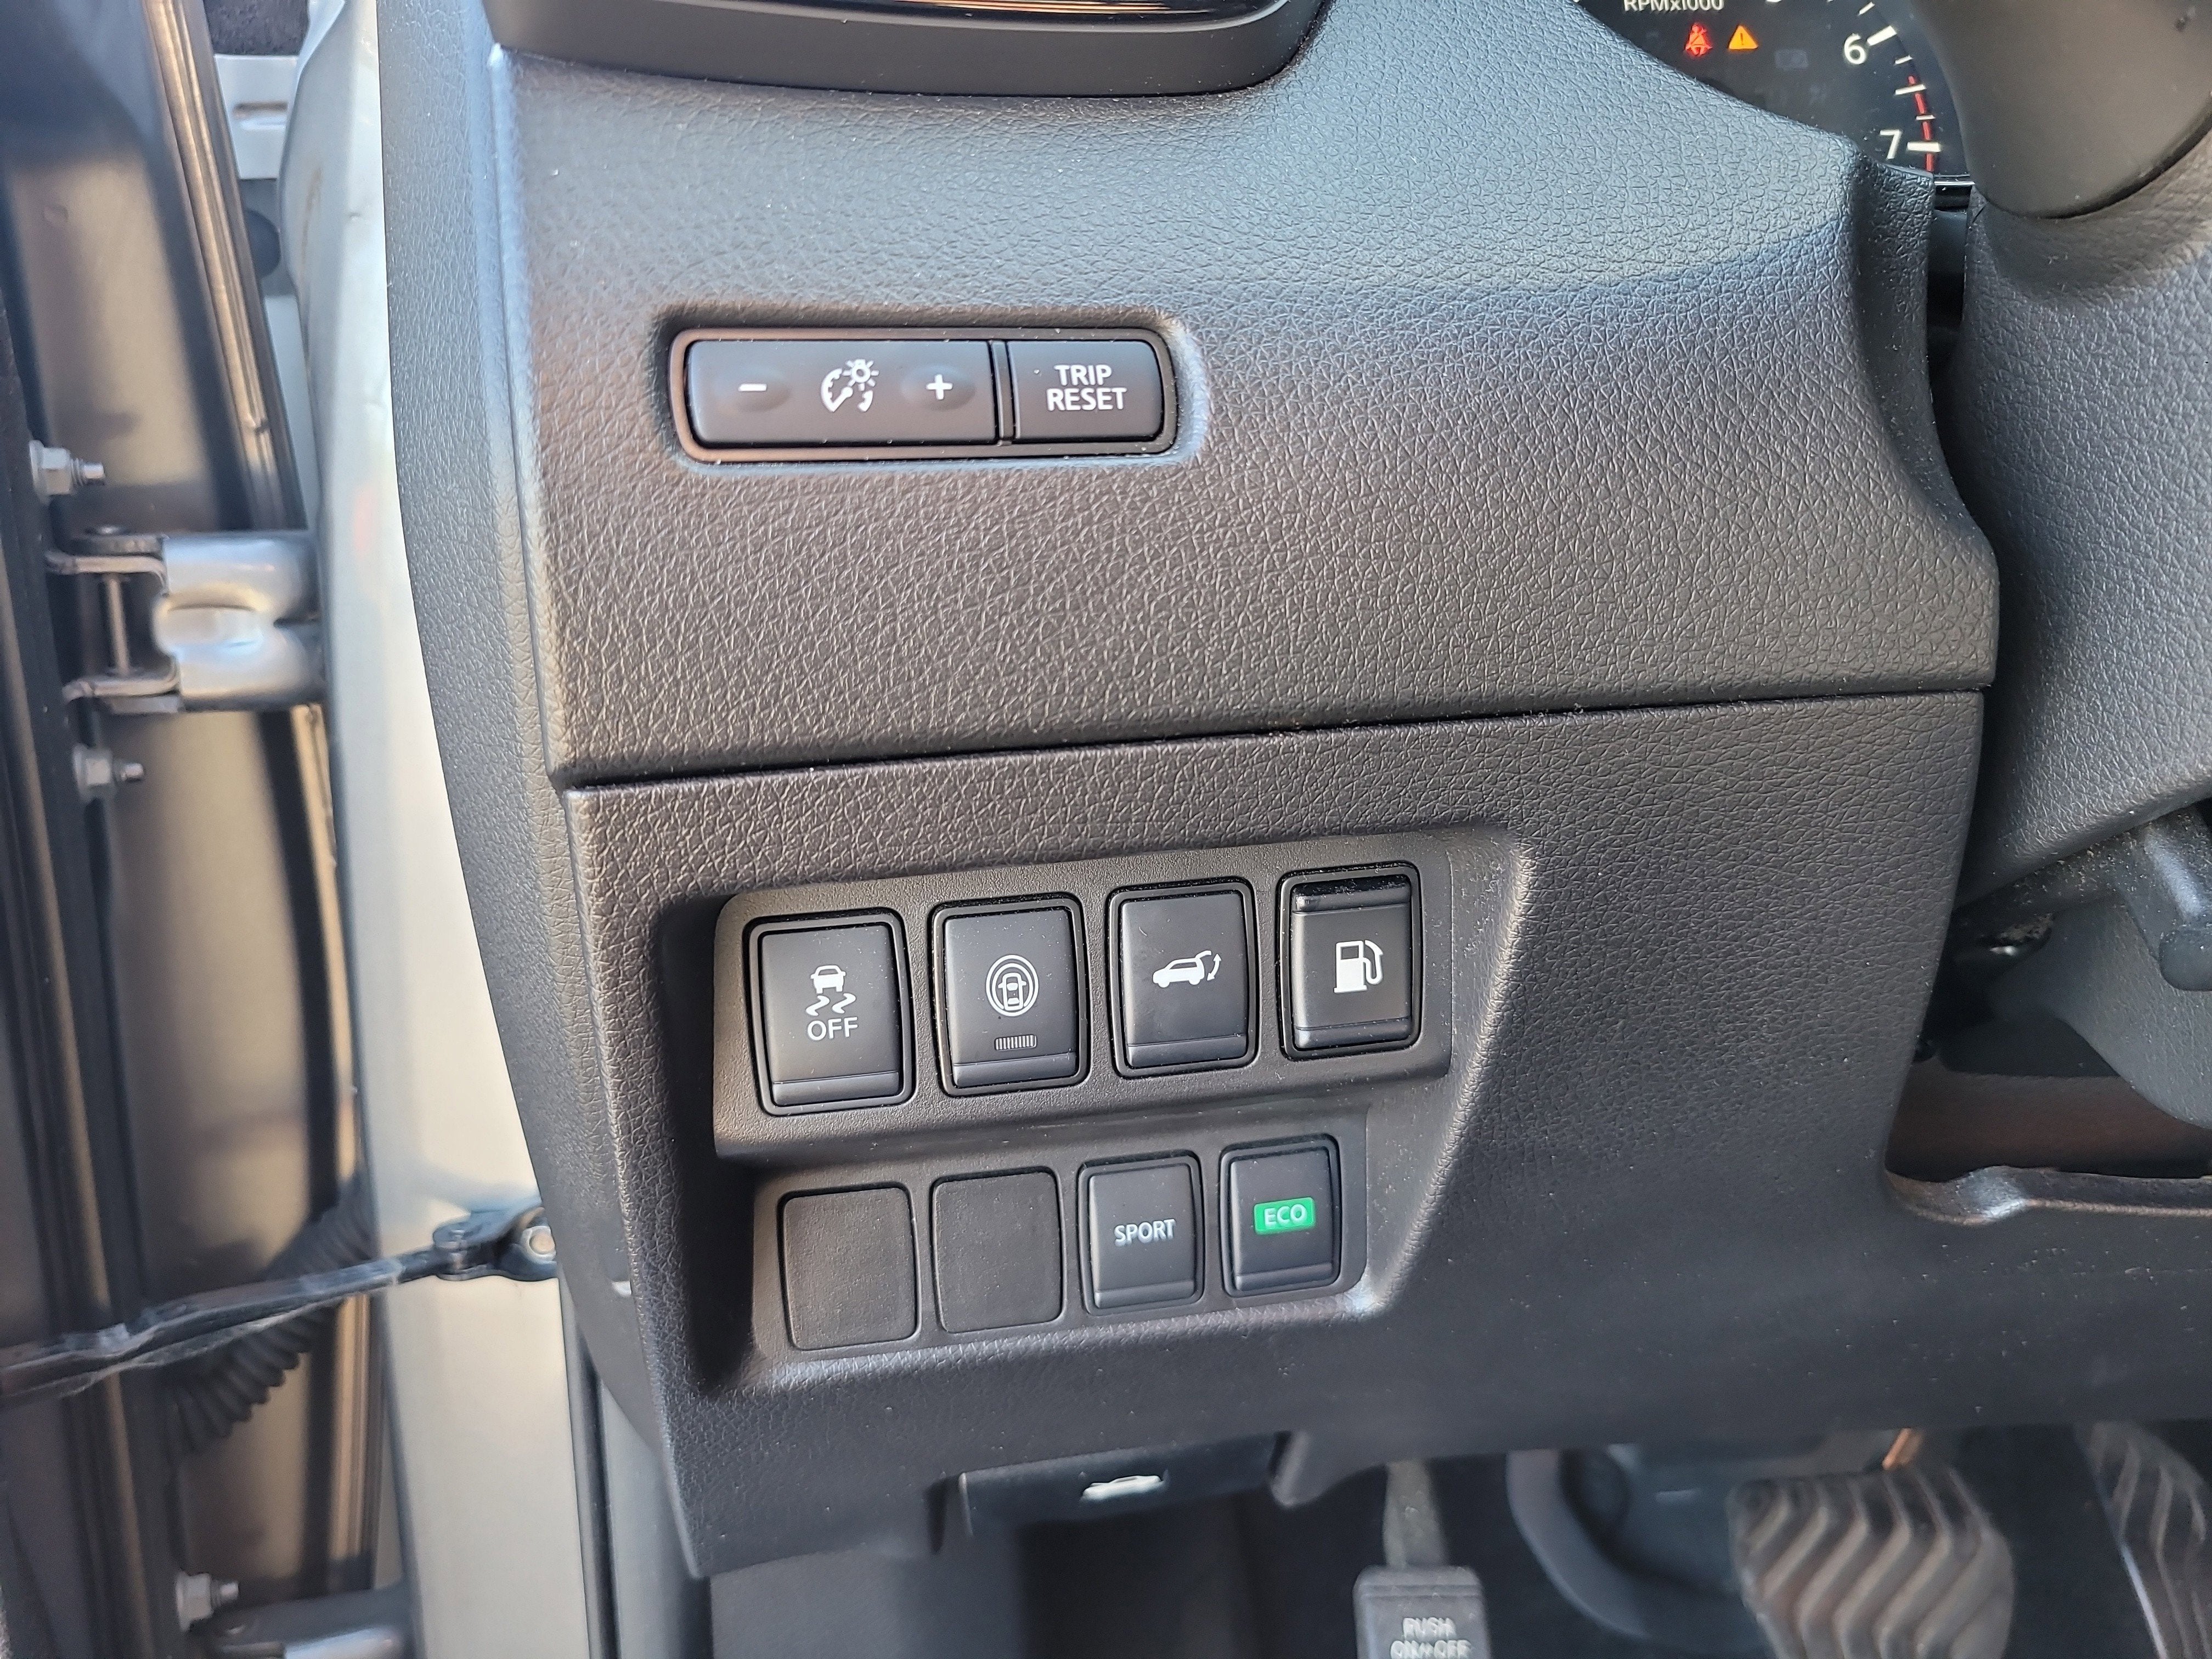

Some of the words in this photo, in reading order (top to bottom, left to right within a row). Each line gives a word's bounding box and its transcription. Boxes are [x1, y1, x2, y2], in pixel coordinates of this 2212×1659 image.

[1844, 33, 1866, 65] 6
[1880, 129, 1902, 160] 7
[1054, 364, 1112, 386] TRIP
[1046, 387, 1127, 411] RESET
[808, 1017, 858, 1040] OFF
[1265, 1204, 1307, 1227] ECO
[1114, 1219, 1176, 1246] SPORT
